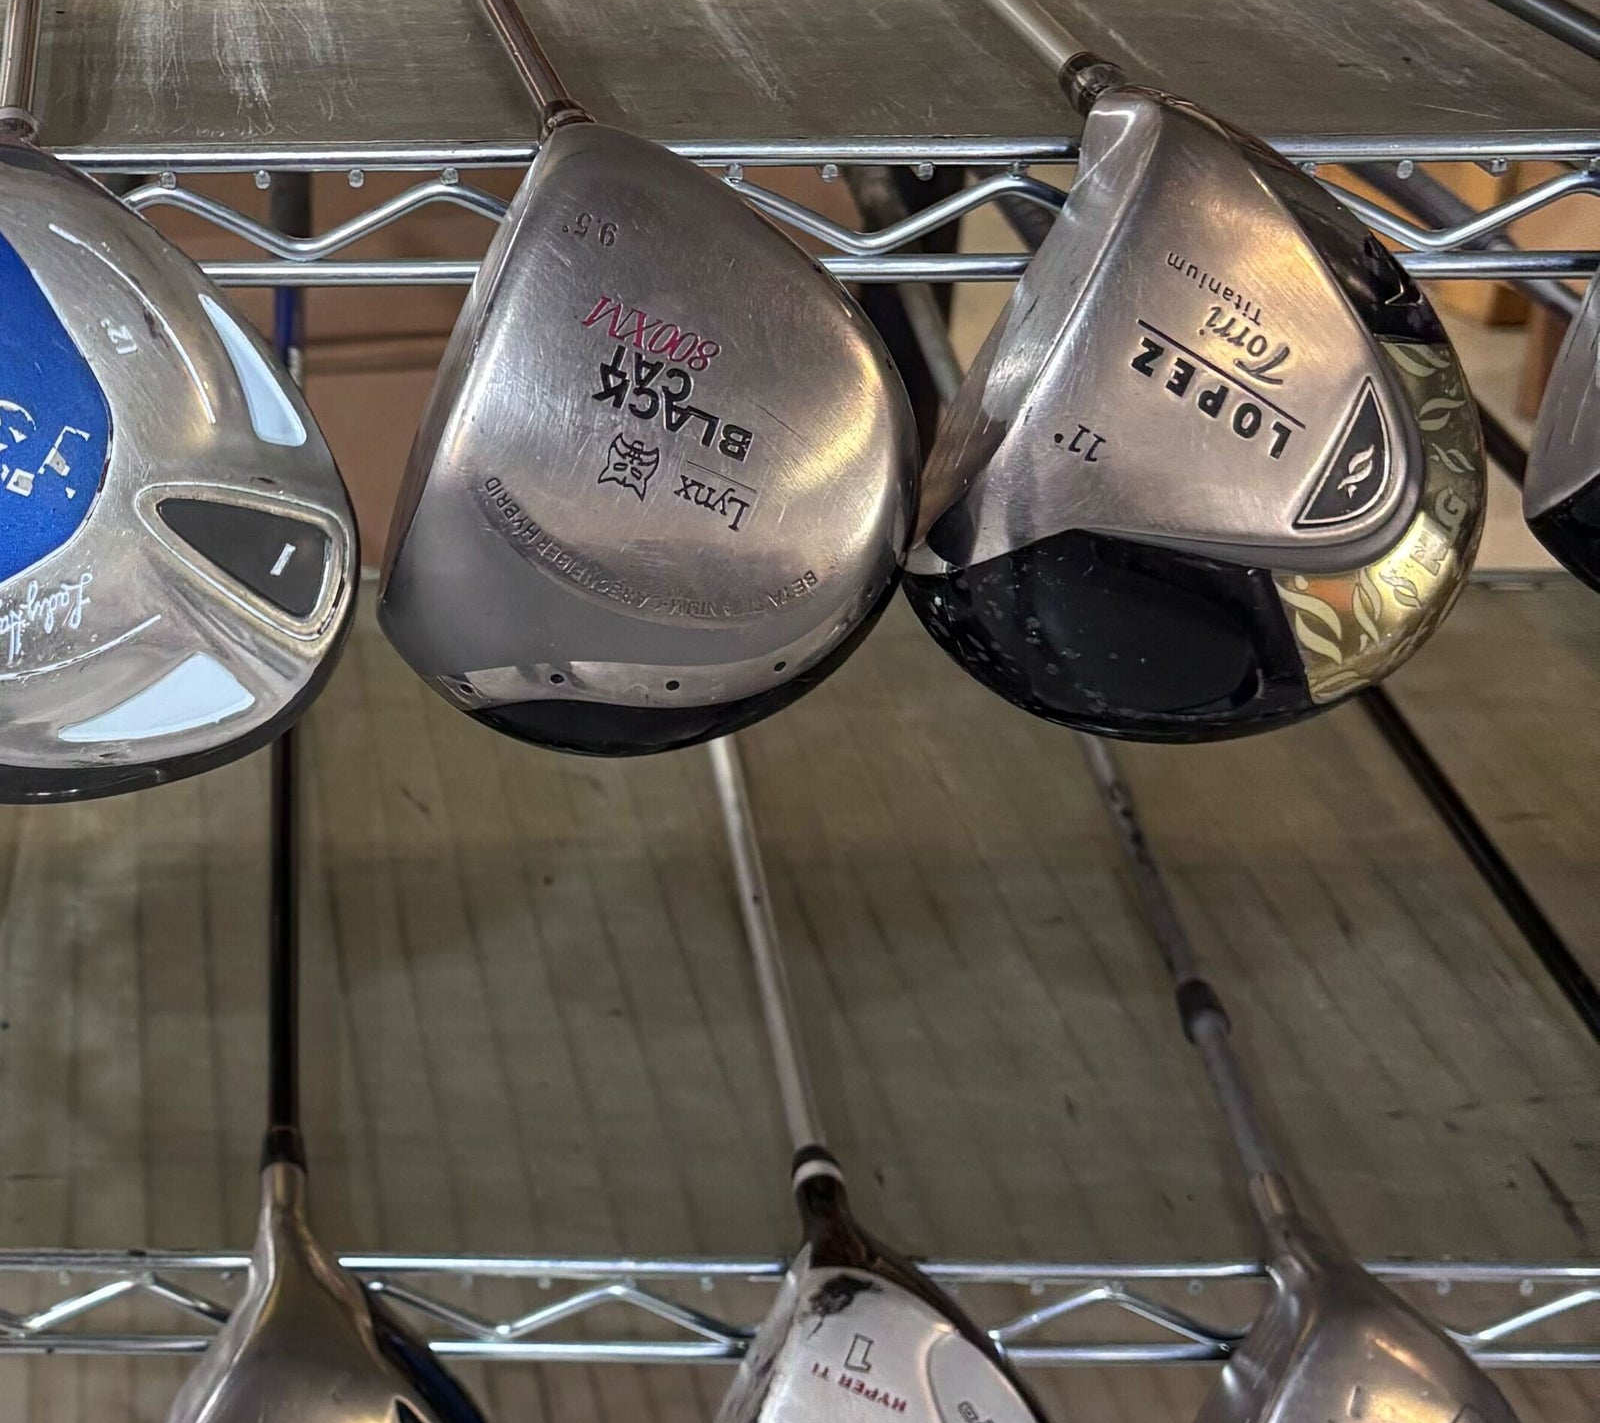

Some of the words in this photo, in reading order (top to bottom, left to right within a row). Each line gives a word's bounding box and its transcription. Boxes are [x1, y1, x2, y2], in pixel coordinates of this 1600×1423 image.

[1166, 252, 1261, 323] Titanium
[583, 296, 721, 370] 800XM
[600, 343, 693, 396] CAT
[1129, 336, 1293, 460] LOPEZ
[592, 379, 754, 464] BLACK
[484, 475, 541, 543] HYBRID
[673, 474, 750, 533] Lynx
[19, 572, 94, 630] Lady
[838, 1372, 907, 1413] HYPER
